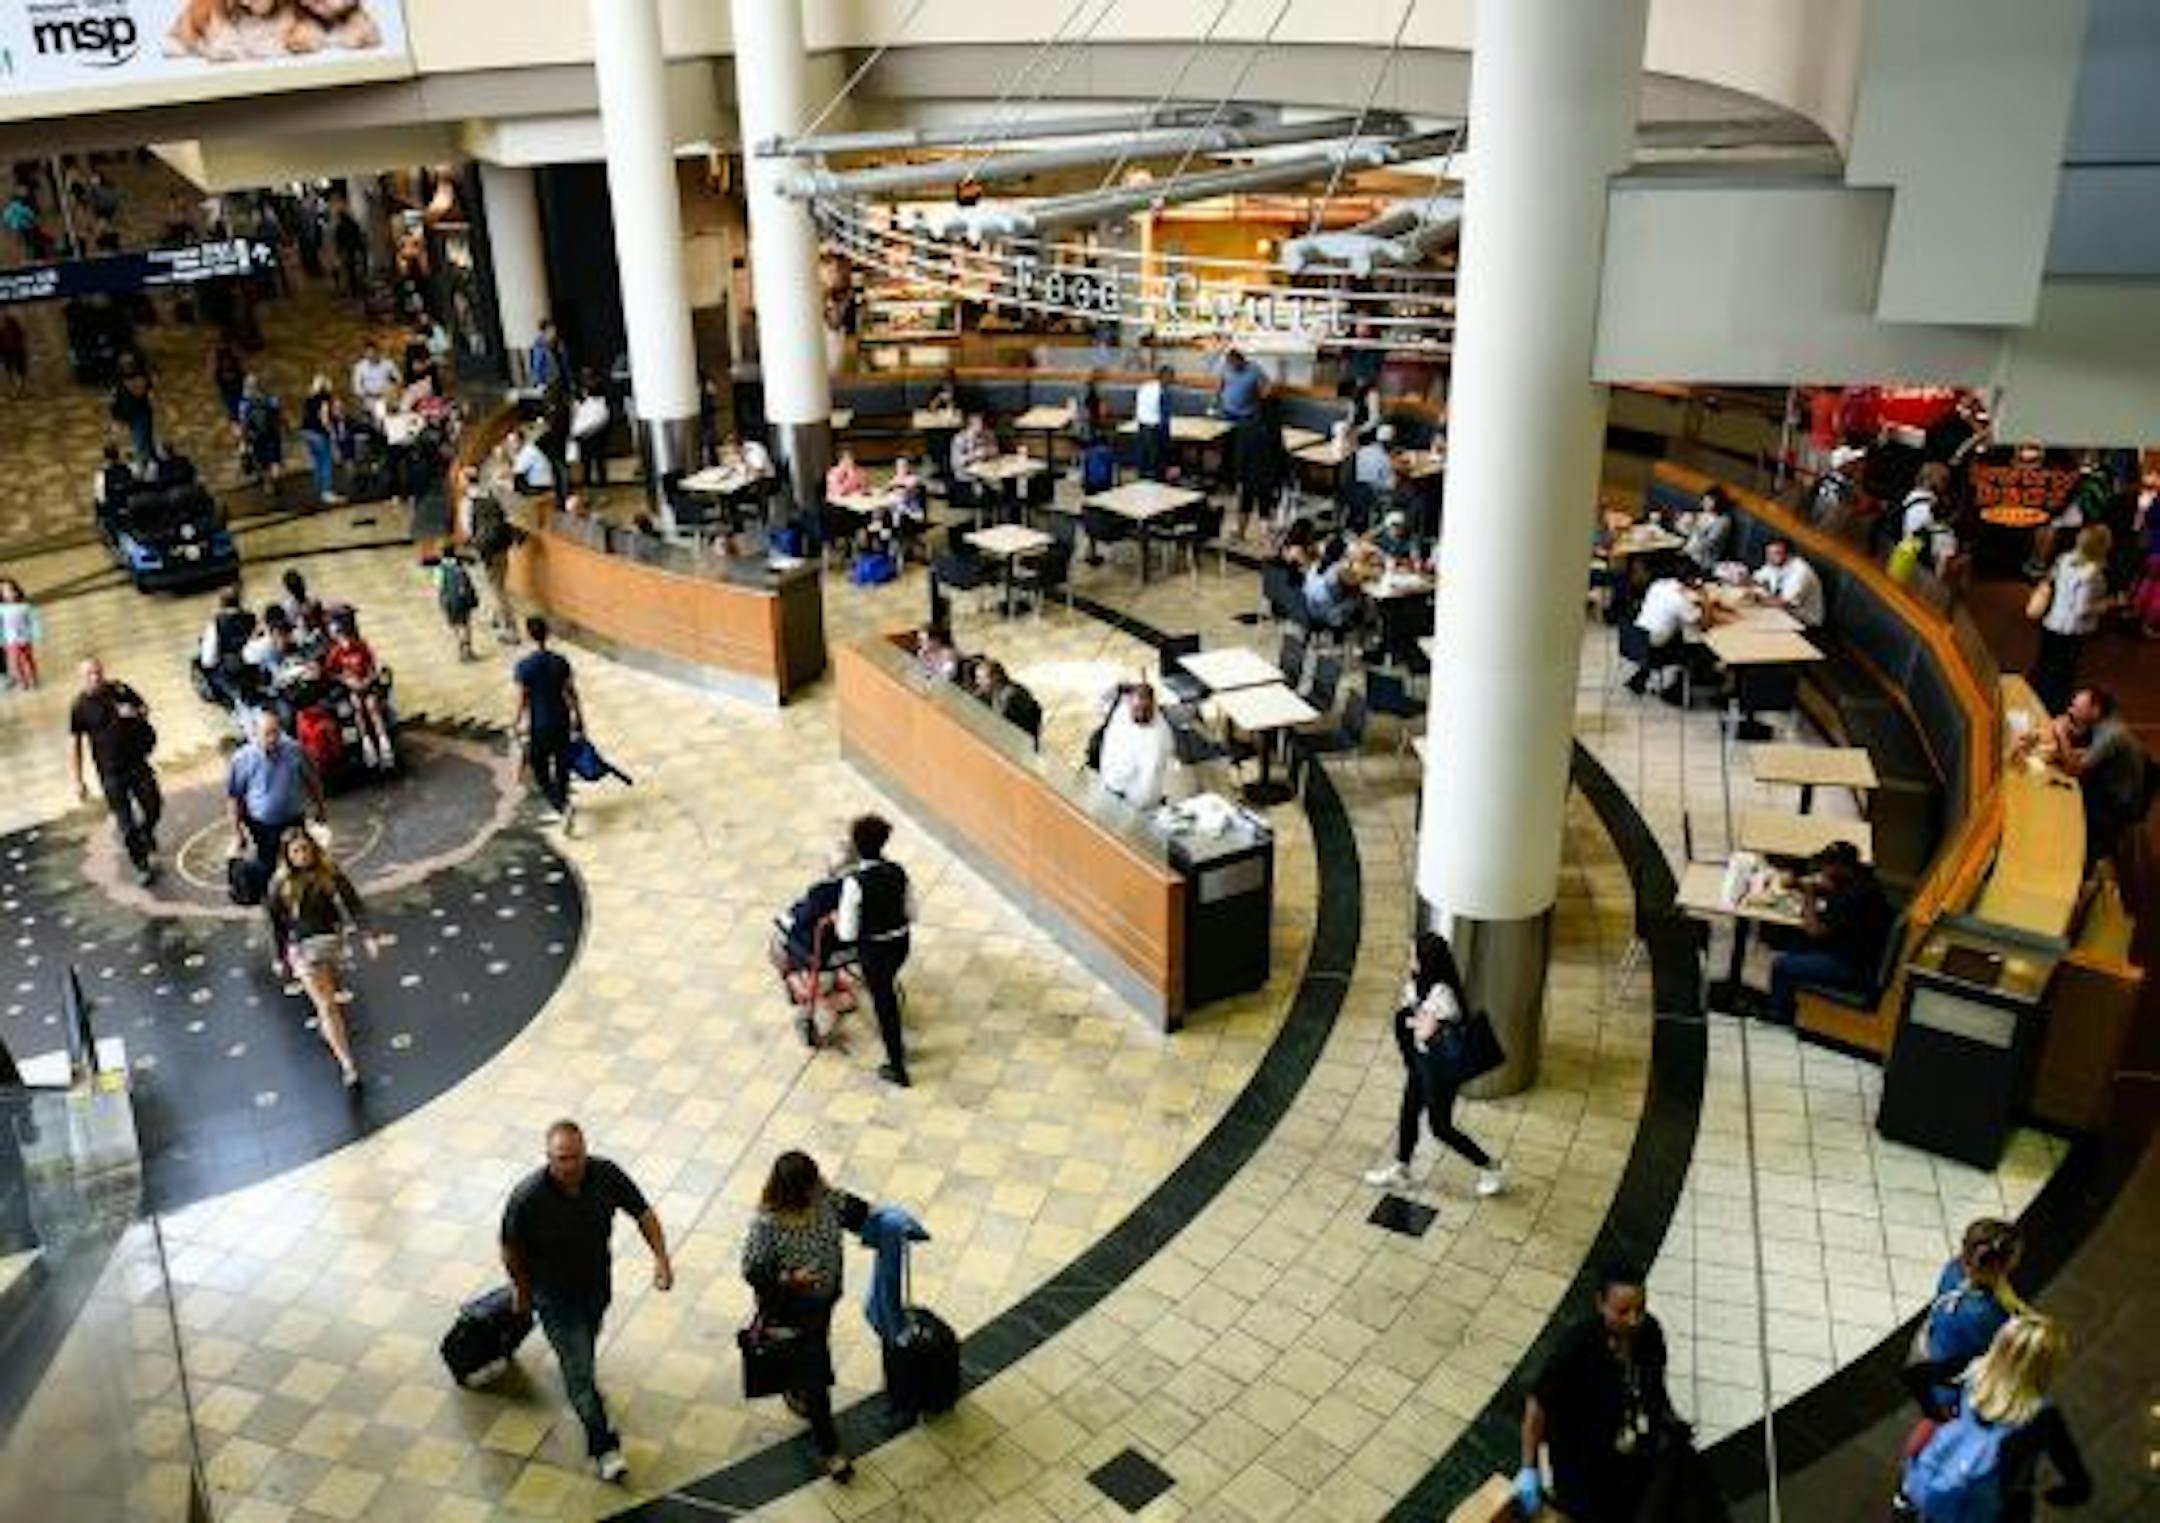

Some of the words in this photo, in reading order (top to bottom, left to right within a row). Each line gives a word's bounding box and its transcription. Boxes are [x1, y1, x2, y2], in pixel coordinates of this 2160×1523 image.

[33, 17, 136, 57] msp
[1015, 255, 1122, 313] Food
[1165, 273, 1351, 338] Court
